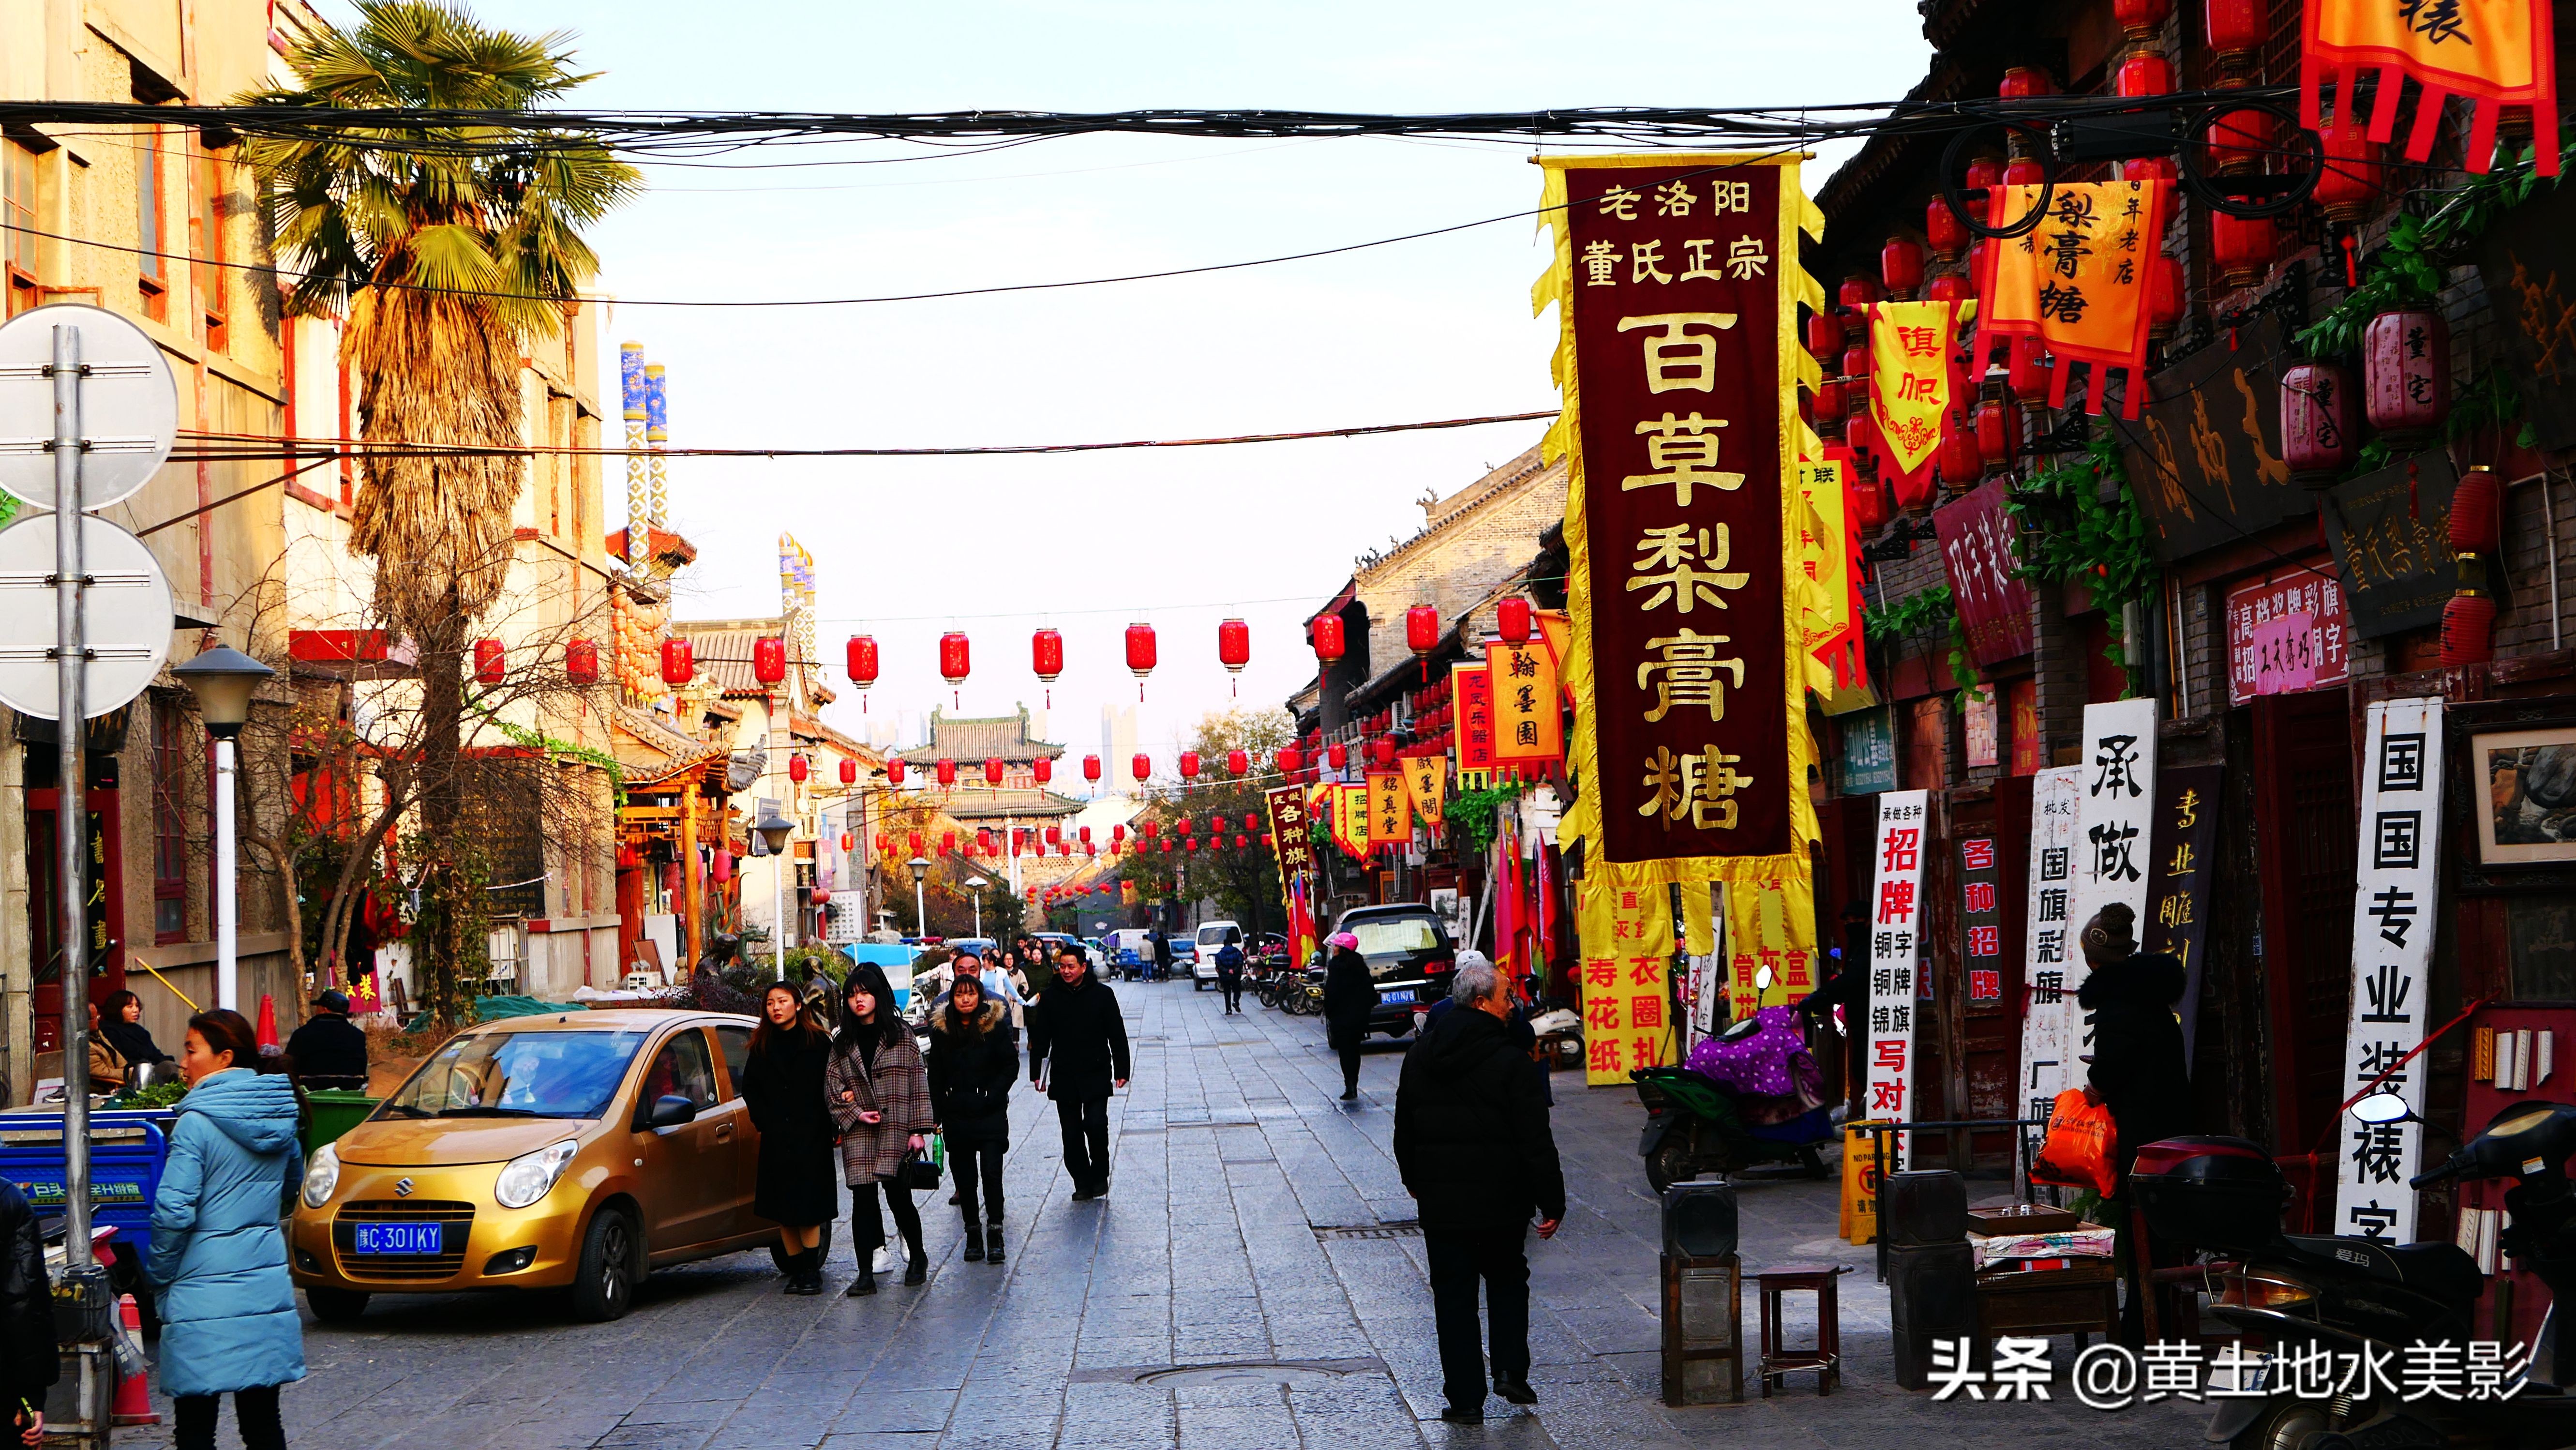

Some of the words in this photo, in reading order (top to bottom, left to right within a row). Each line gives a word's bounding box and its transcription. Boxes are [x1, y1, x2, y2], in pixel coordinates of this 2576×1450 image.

[1600, 180, 1750, 221] 老洛阳
[1581, 235, 1769, 287] 董氏正宗
[2039, 189, 2101, 324] 梨膏糖
[2405, 327, 2433, 406] 董宅
[2312, 378, 2339, 450] 董宅
[1617, 312, 1754, 831] 百草梨膏糖
[1468, 675, 1488, 762] 龙凤乐器店
[1273, 791, 1302, 805] 定做
[1883, 804, 1922, 822] 承做各种
[2043, 799, 2071, 816] 批发
[1878, 828, 1919, 926] 招牌
[1962, 840, 2000, 1000] 各种招牌
[2035, 847, 2068, 1005] 国旗彩旗
[1874, 930, 1913, 960] 铜字
[1587, 957, 1662, 988] 寿衣
[1873, 967, 1911, 997] 铜牌
[1588, 995, 1662, 1031] 花圈
[1872, 1005, 1910, 1034] 锦旗
[1589, 1036, 1664, 1073] 纸扎
[1863, 1152, 1890, 1162] PARNG
[2335, 1248, 2370, 1267] 爱玛
